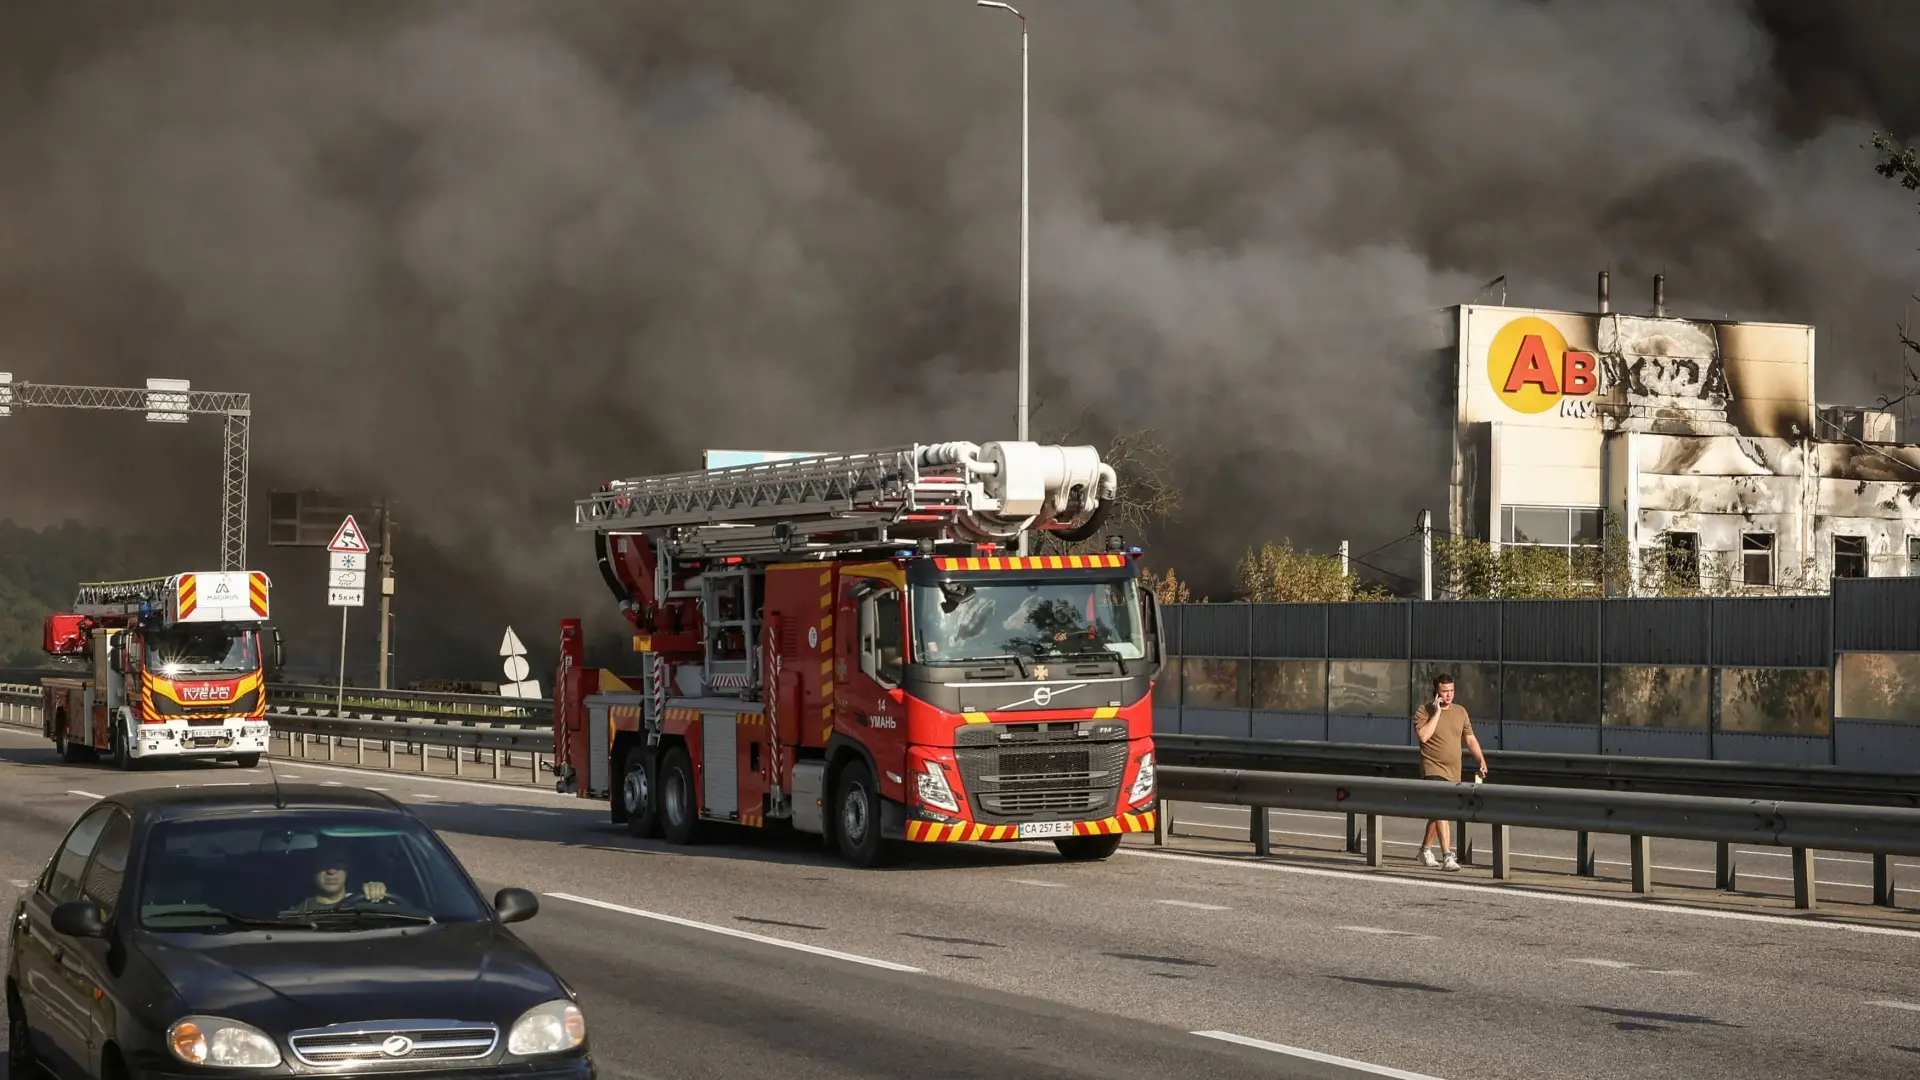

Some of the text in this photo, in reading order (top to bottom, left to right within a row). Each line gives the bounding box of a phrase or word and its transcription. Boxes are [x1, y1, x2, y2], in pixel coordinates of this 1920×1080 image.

[183, 691, 229, 700] IVECO
[877, 698, 886, 712] 14
[870, 716, 896, 729] УМАНЬ
[1025, 823, 1062, 834] CA 257 E
